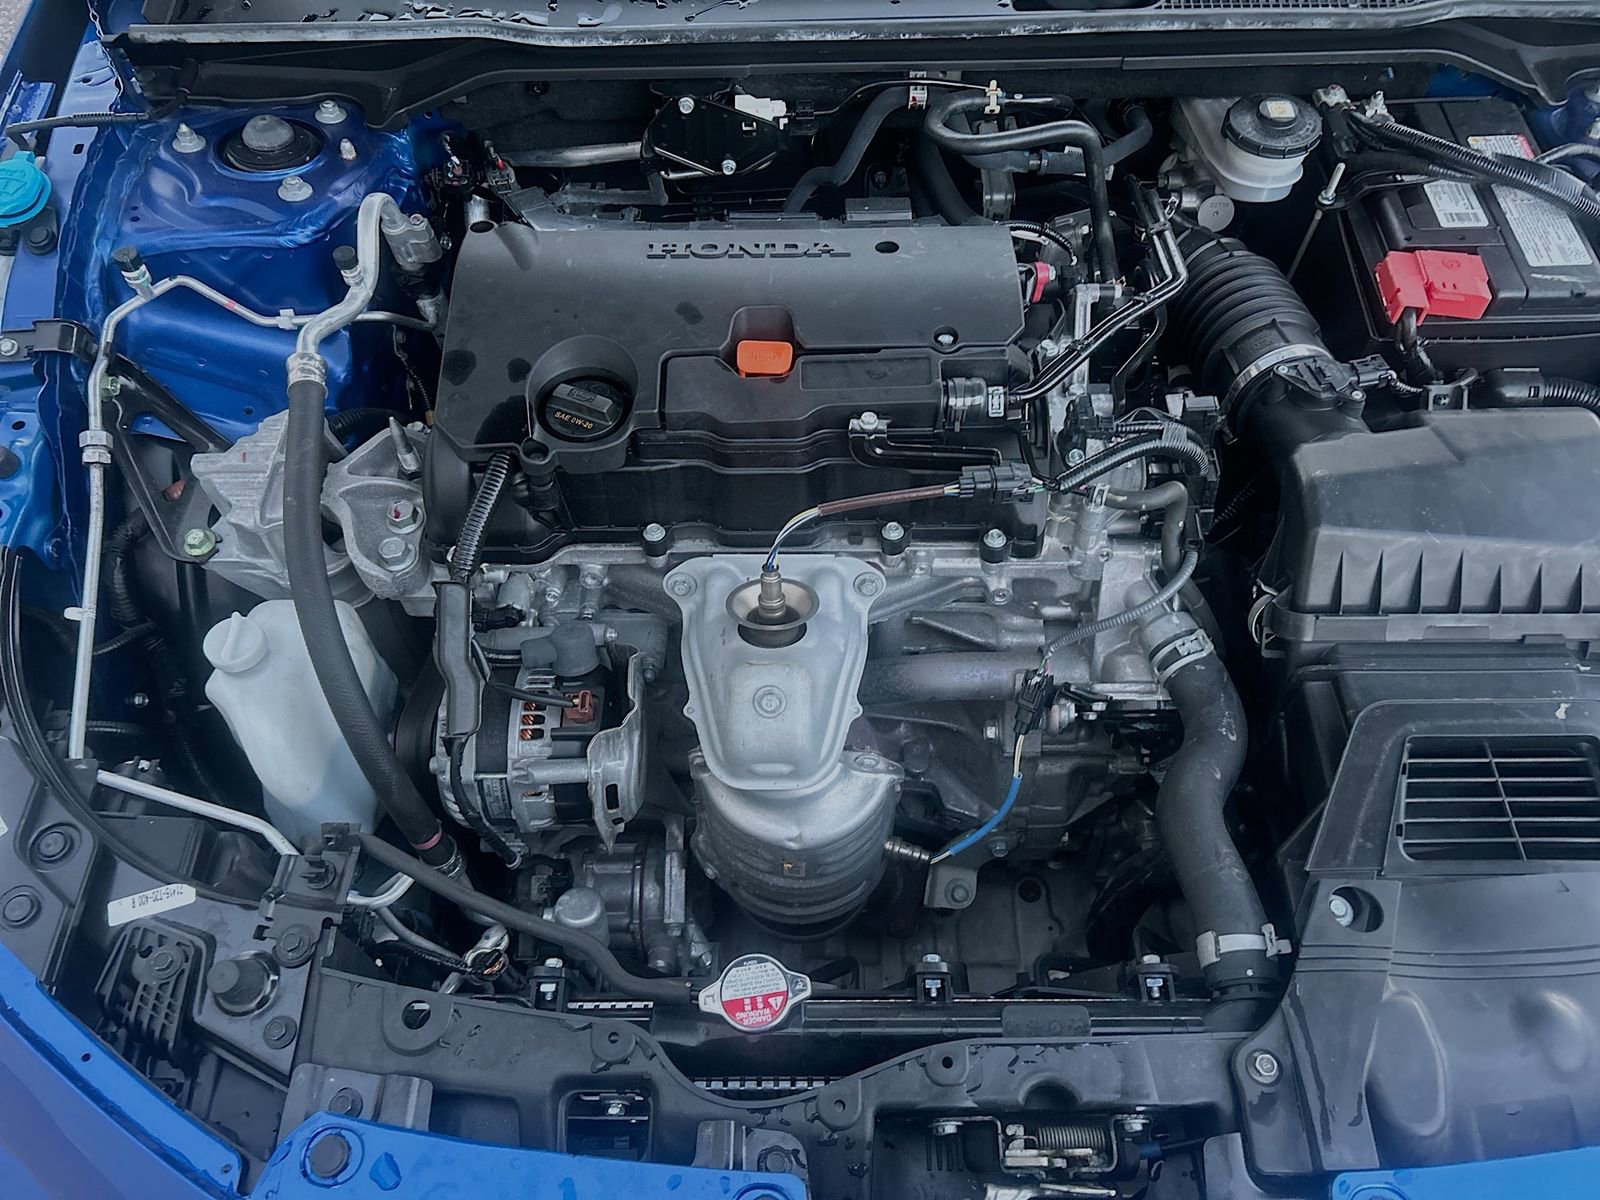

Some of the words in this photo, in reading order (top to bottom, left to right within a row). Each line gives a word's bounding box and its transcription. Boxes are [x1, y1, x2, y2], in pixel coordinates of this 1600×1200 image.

[646, 243, 851, 259] HONDA
[554, 411, 570, 421] SAE
[570, 417, 594, 430] 0W-20
[735, 1008, 771, 1020] WARNING
[742, 1014, 772, 1025] DANGER
